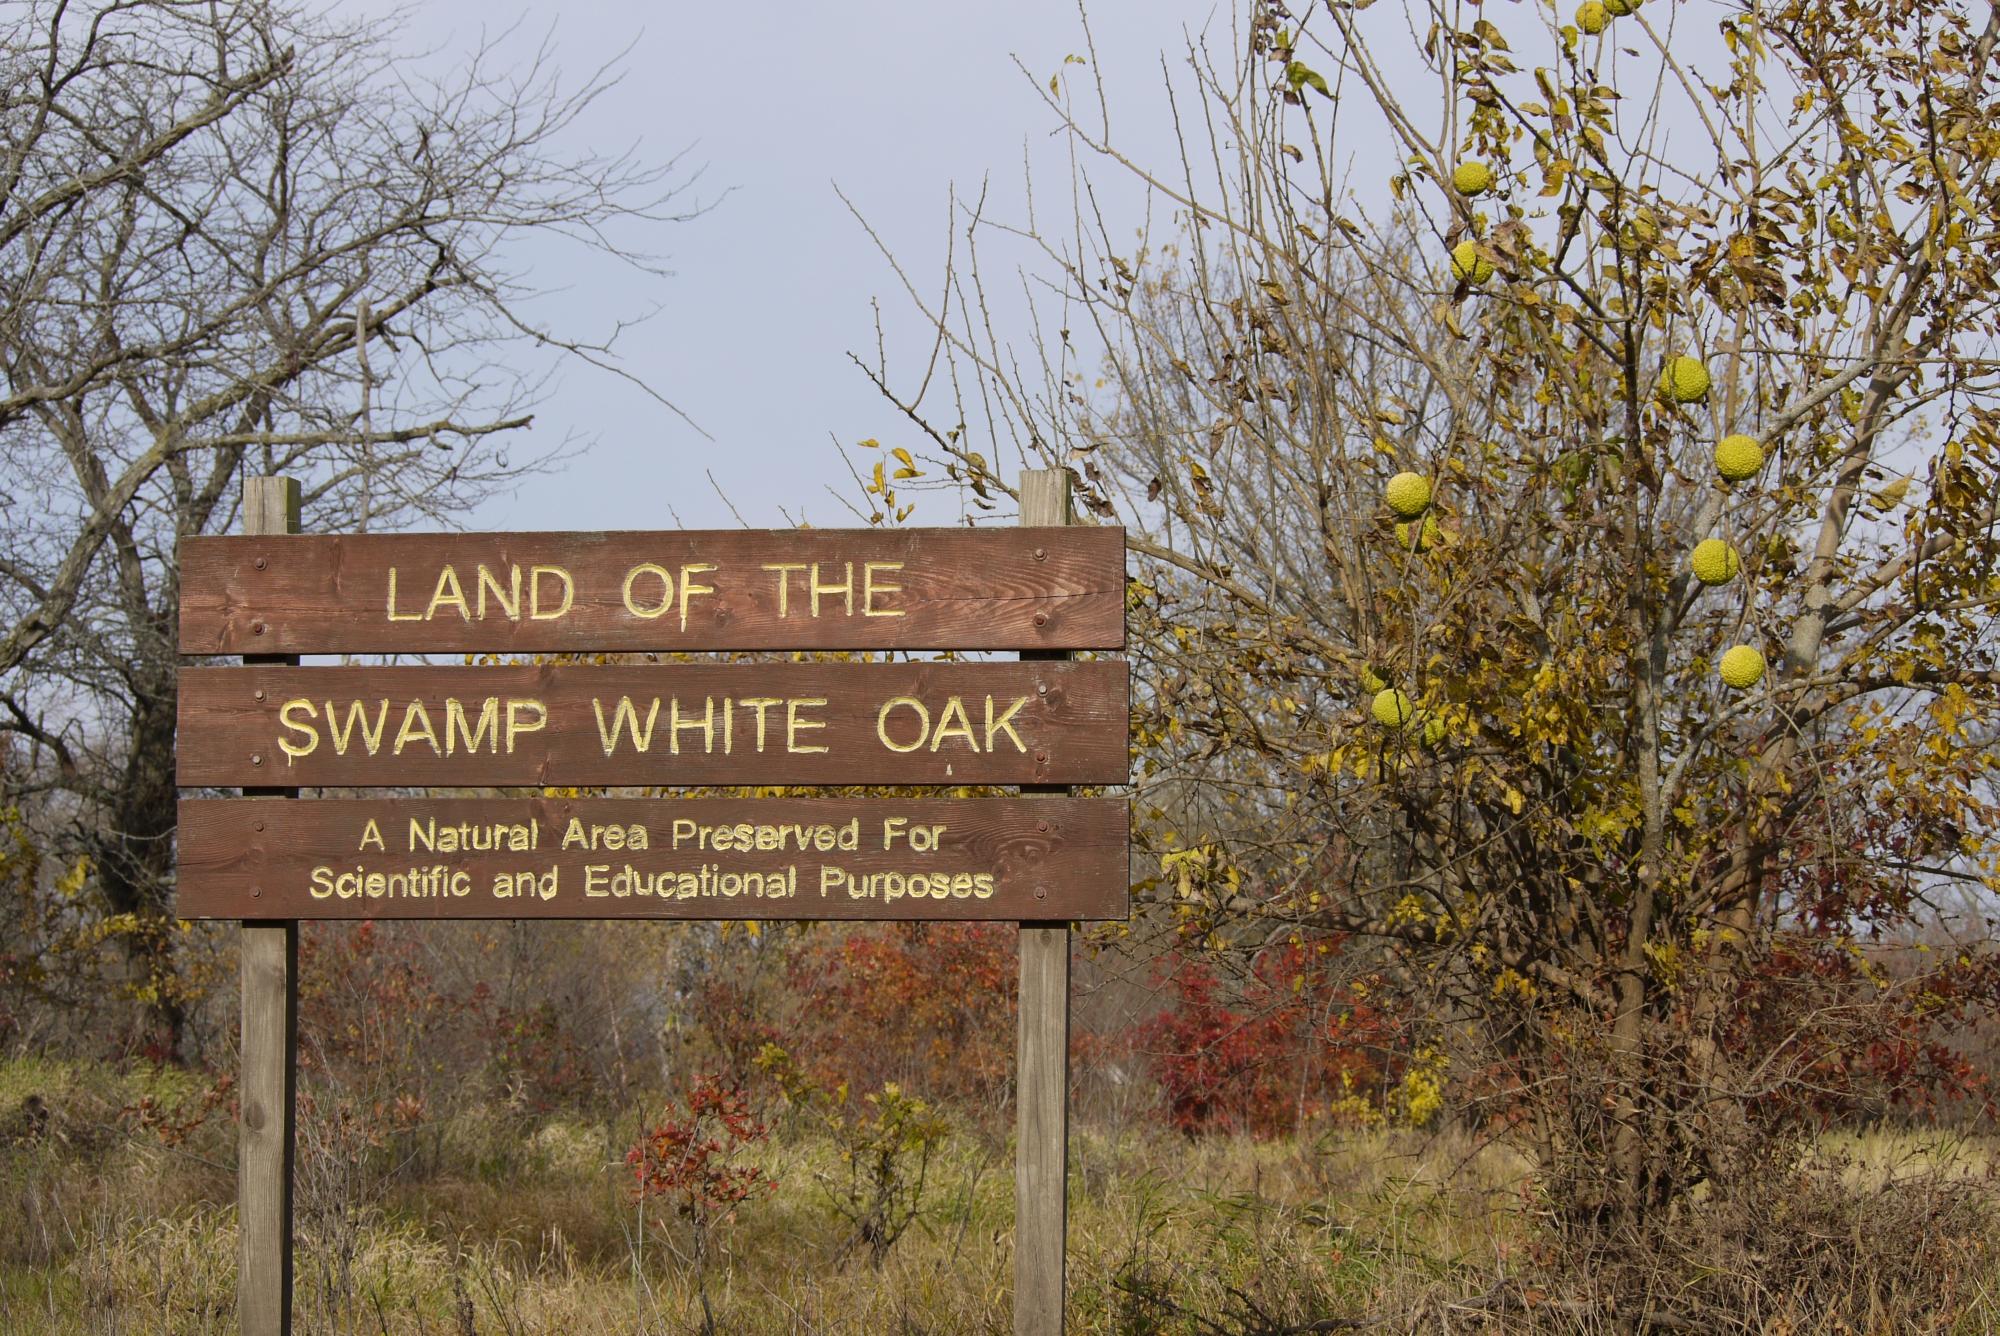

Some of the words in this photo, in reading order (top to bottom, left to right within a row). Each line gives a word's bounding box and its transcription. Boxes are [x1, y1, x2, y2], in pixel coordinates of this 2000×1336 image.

[387, 563, 575, 622] LAND
[622, 562, 718, 623] OF
[762, 561, 906, 618] THE
[278, 697, 548, 758] SWAMP
[592, 695, 829, 756] WHITE
[877, 694, 1029, 753] OAK
[358, 818, 386, 852] A
[409, 816, 538, 853] Natural
[561, 817, 649, 851] Area
[672, 817, 859, 852] Preserved
[883, 817, 947, 852] For
[309, 865, 471, 899] Scientific
[492, 865, 559, 901] and
[585, 864, 797, 900] Educational
[820, 864, 995, 904] Purposes
